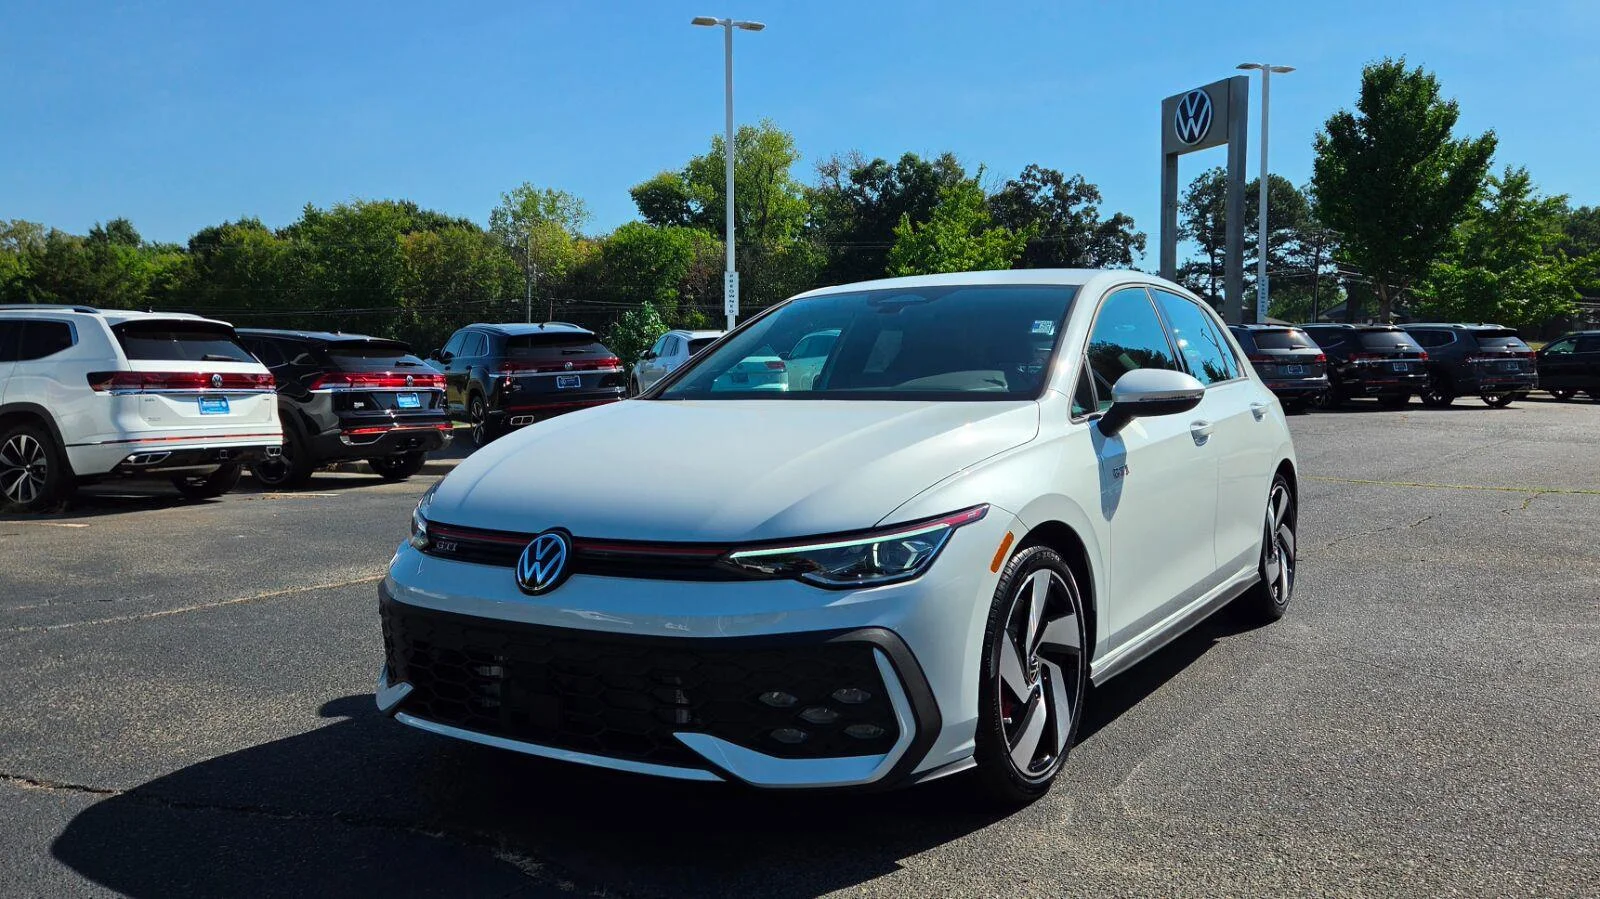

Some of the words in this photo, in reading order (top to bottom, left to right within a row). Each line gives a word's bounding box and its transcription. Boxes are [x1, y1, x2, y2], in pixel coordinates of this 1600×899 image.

[1175, 90, 1212, 144] VW
[436, 541, 458, 552] GTI
[517, 533, 567, 591] VW
